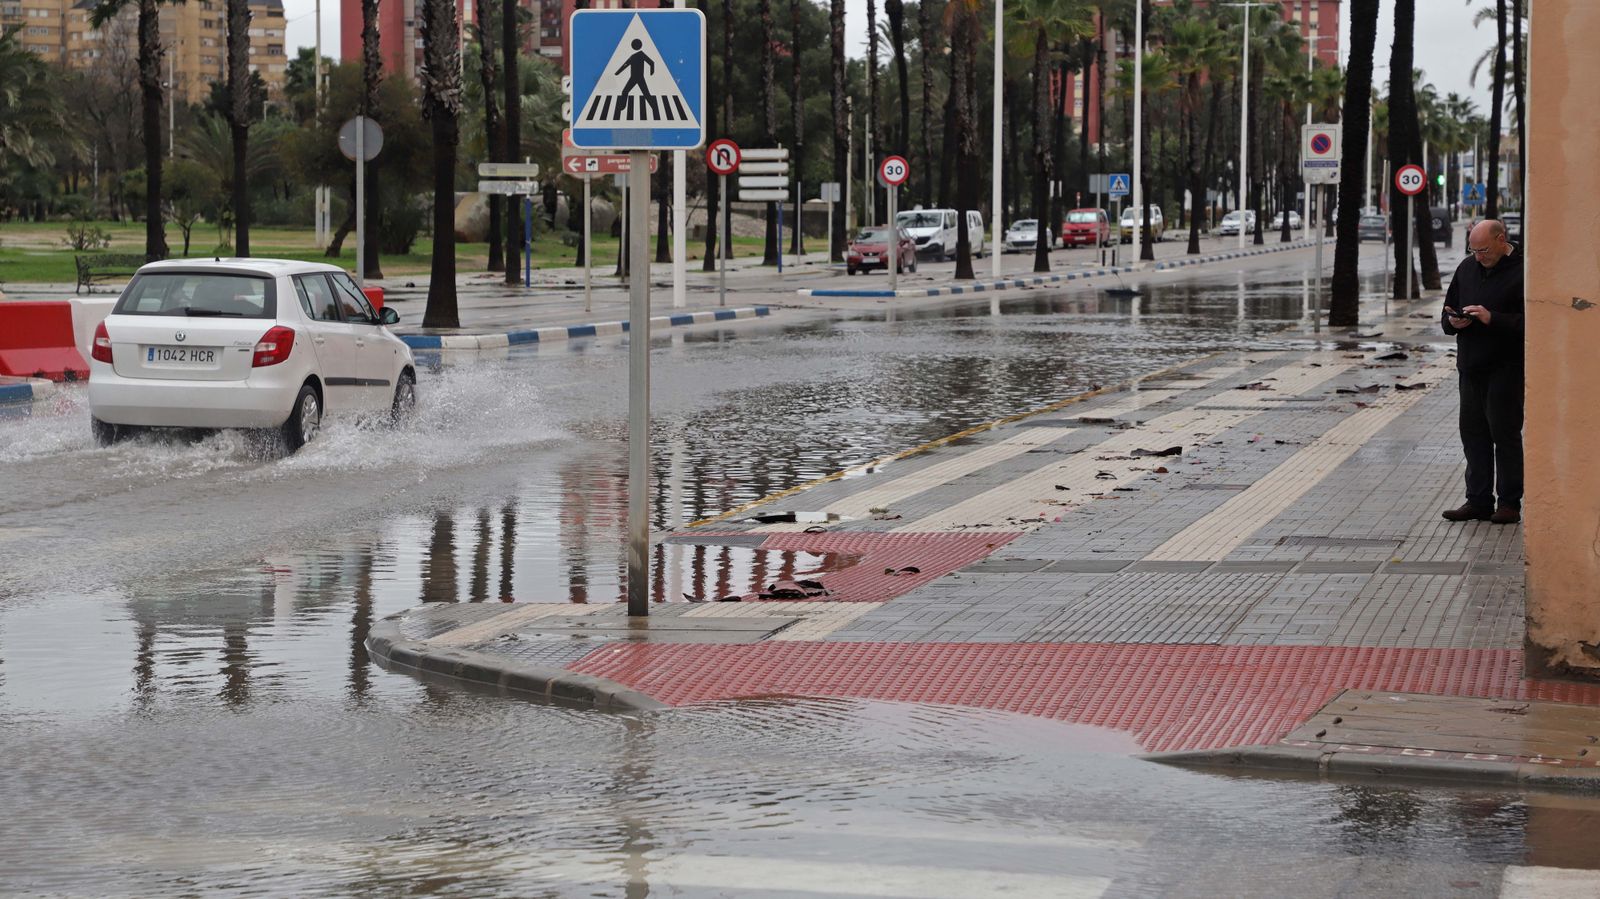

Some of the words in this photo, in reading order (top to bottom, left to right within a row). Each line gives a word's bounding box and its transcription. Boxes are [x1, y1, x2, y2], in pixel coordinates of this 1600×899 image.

[887, 166, 903, 175] 30
[1402, 175, 1420, 184] 30
[158, 349, 186, 361] 1042
[190, 350, 214, 362] HCR
